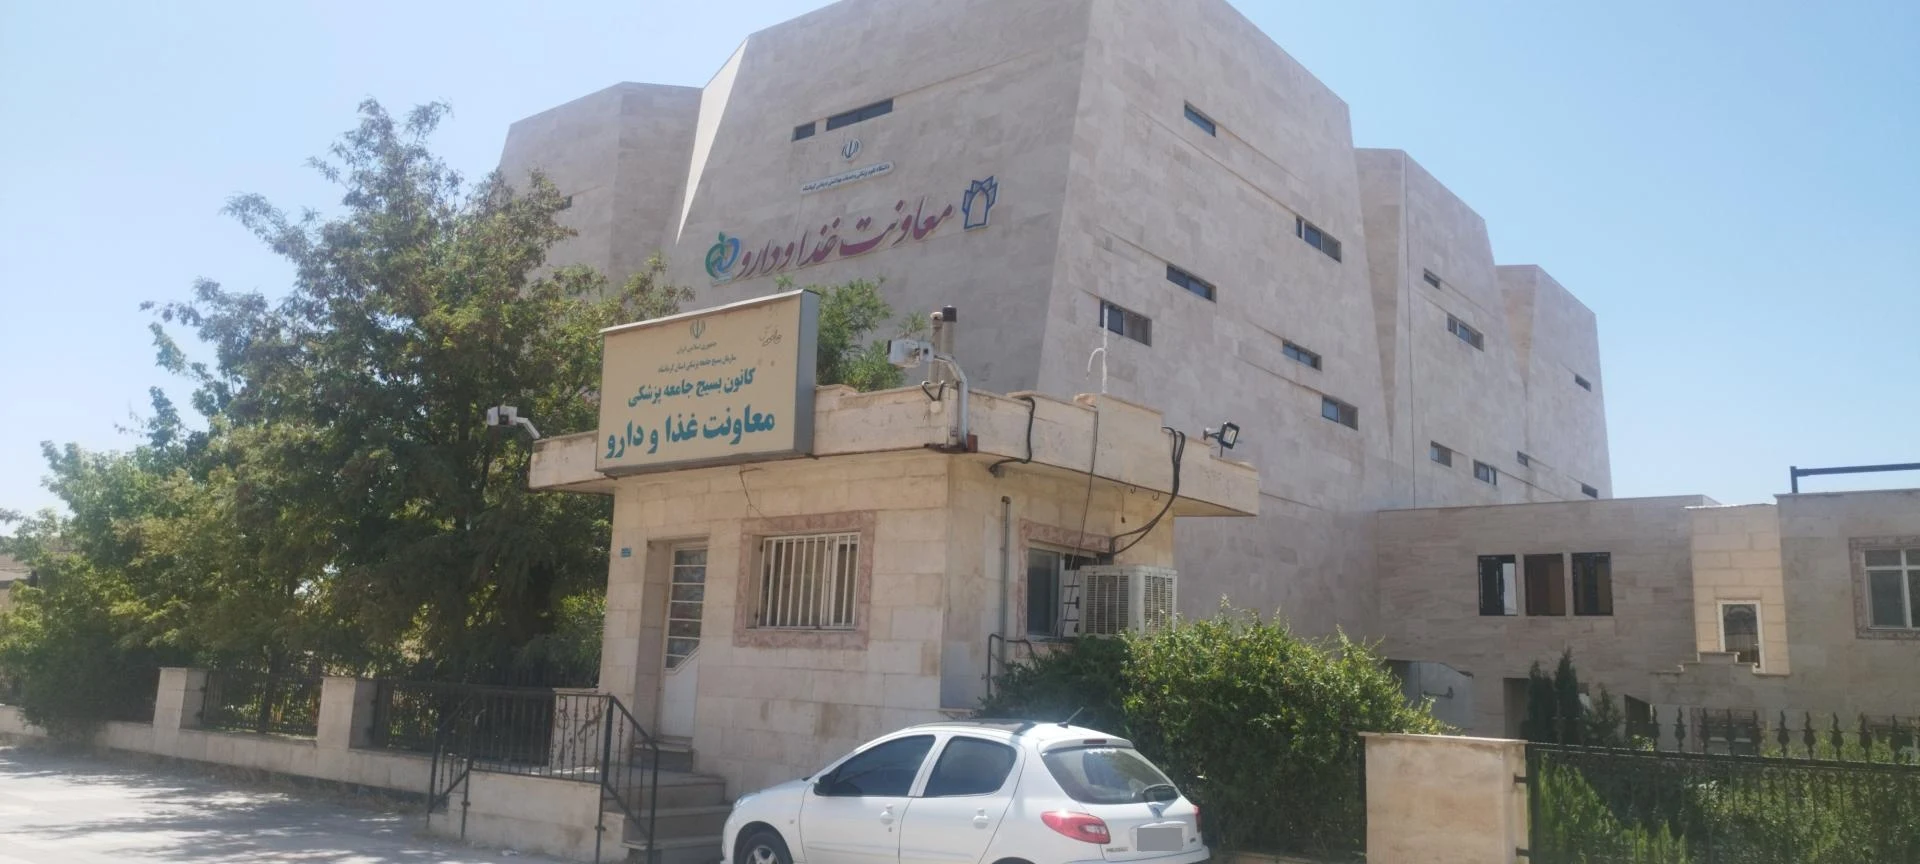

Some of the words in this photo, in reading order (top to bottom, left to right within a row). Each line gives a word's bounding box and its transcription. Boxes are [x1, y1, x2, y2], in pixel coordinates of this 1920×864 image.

[839, 196, 953, 257] معاونت
[776, 241, 795, 271] و
[796, 217, 840, 267] غذا
[735, 239, 781, 278] دارو
[663, 379, 694, 398] جامعه
[696, 377, 722, 397] بسیج
[724, 367, 756, 393] کانون
[628, 384, 662, 407] پزشکی
[605, 420, 644, 459] دارو
[665, 413, 698, 443] غذا
[703, 404, 775, 445] معاونت
[647, 429, 659, 454] و
